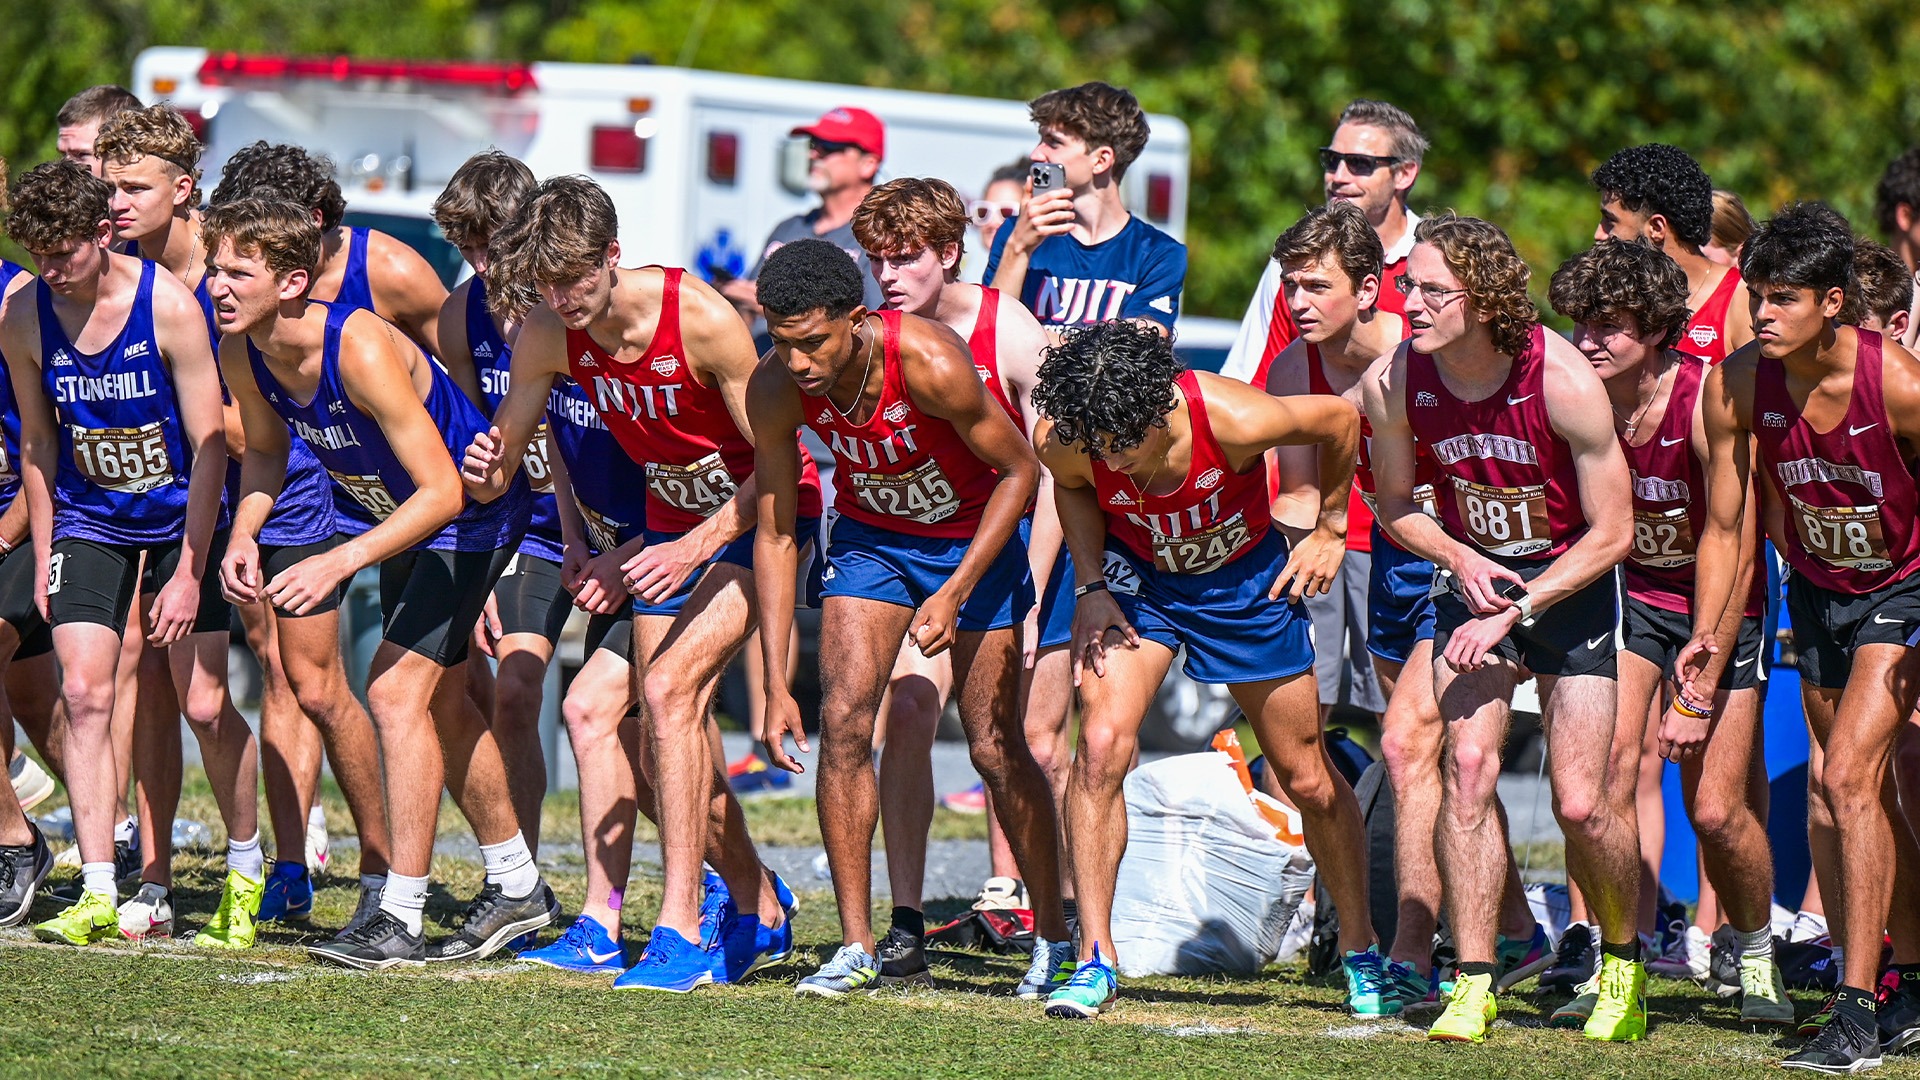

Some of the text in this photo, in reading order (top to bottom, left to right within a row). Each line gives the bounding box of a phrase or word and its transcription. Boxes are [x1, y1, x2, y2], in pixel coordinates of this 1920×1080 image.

[1034, 276, 1137, 325] NJIT
[124, 340, 147, 358] NEC
[56, 370, 157, 403] STONEHILL
[592, 375, 683, 421] NJIT
[131, 432, 148, 440] SHORT
[830, 424, 918, 469] NJIT
[1433, 433, 1538, 467] LAFAYETTE
[75, 436, 168, 480] 1655
[709, 460, 721, 468] RUN
[146, 477, 166, 490] asics
[649, 468, 740, 510] 1243
[858, 469, 955, 516] 1245
[937, 504, 957, 518] asics
[1109, 498, 1135, 506] adidas
[1465, 495, 1533, 541] 881
[1157, 526, 1249, 573] 1242
[1523, 543, 1545, 553] asics
[1632, 522, 1682, 555] 82
[1802, 514, 1873, 557] 878
[49, 562, 58, 587] 5
[1102, 557, 1136, 589] 42
[1672, 557, 1693, 567] asics
[1863, 561, 1884, 570] asics
[1856, 997, 1876, 1012] CH
